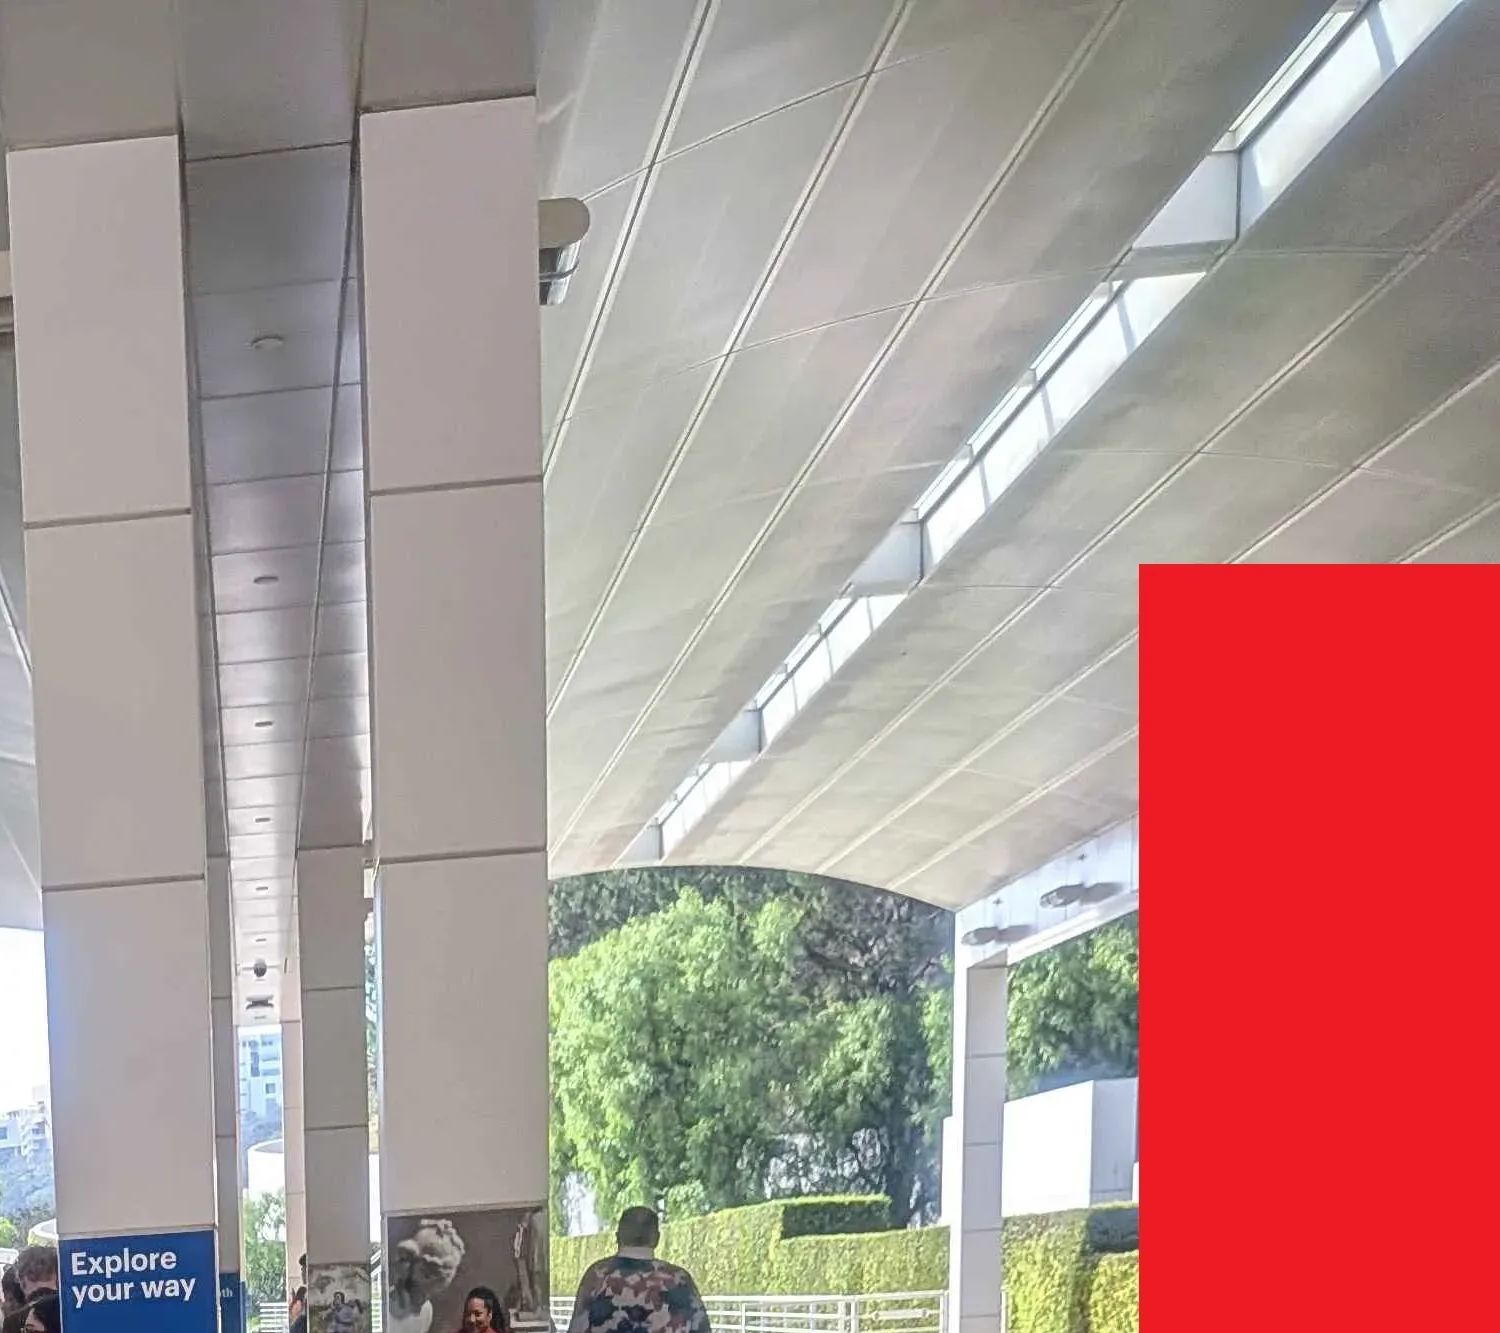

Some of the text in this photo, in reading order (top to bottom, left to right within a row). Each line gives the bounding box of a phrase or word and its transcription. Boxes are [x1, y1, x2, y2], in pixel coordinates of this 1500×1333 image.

[71, 1248, 177, 1278] Explore
[72, 1278, 196, 1308] your way
